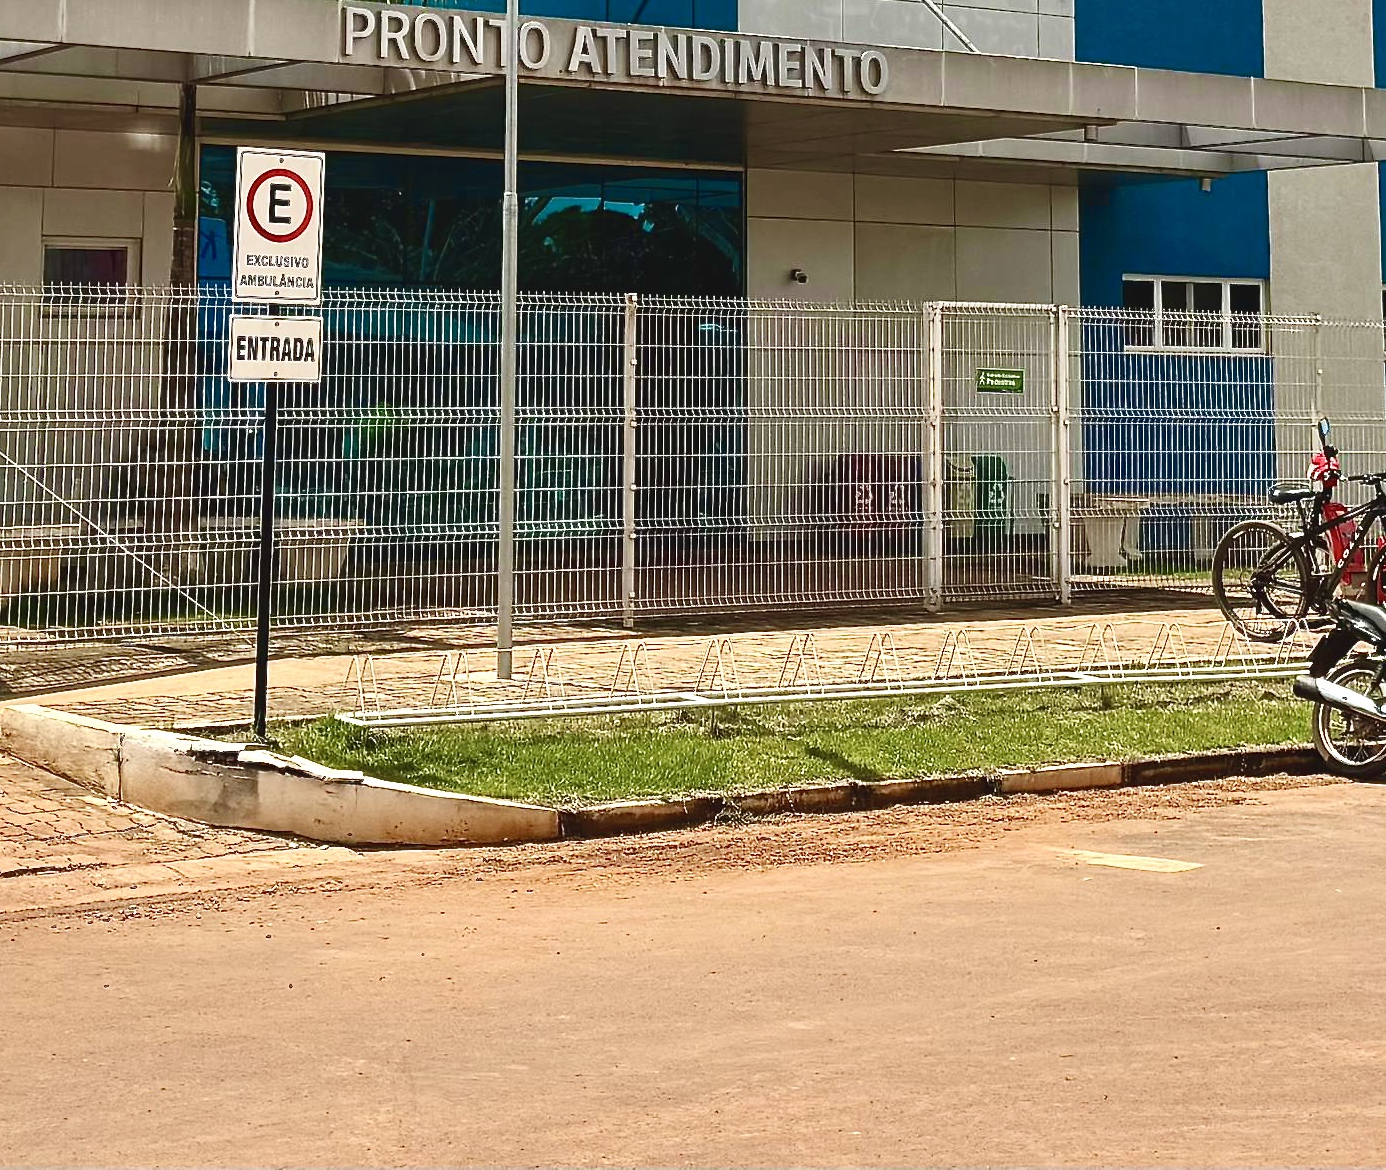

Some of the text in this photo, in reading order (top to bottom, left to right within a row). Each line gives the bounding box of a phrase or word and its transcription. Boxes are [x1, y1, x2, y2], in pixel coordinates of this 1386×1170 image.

[344, 6, 890, 95] PRONTO ATENDIMENTO
[269, 183, 292, 224] E
[246, 254, 310, 268] EXCLUSIVO
[239, 273, 314, 289] AMBULÂNCIA
[236, 335, 315, 362] ENTRADA
